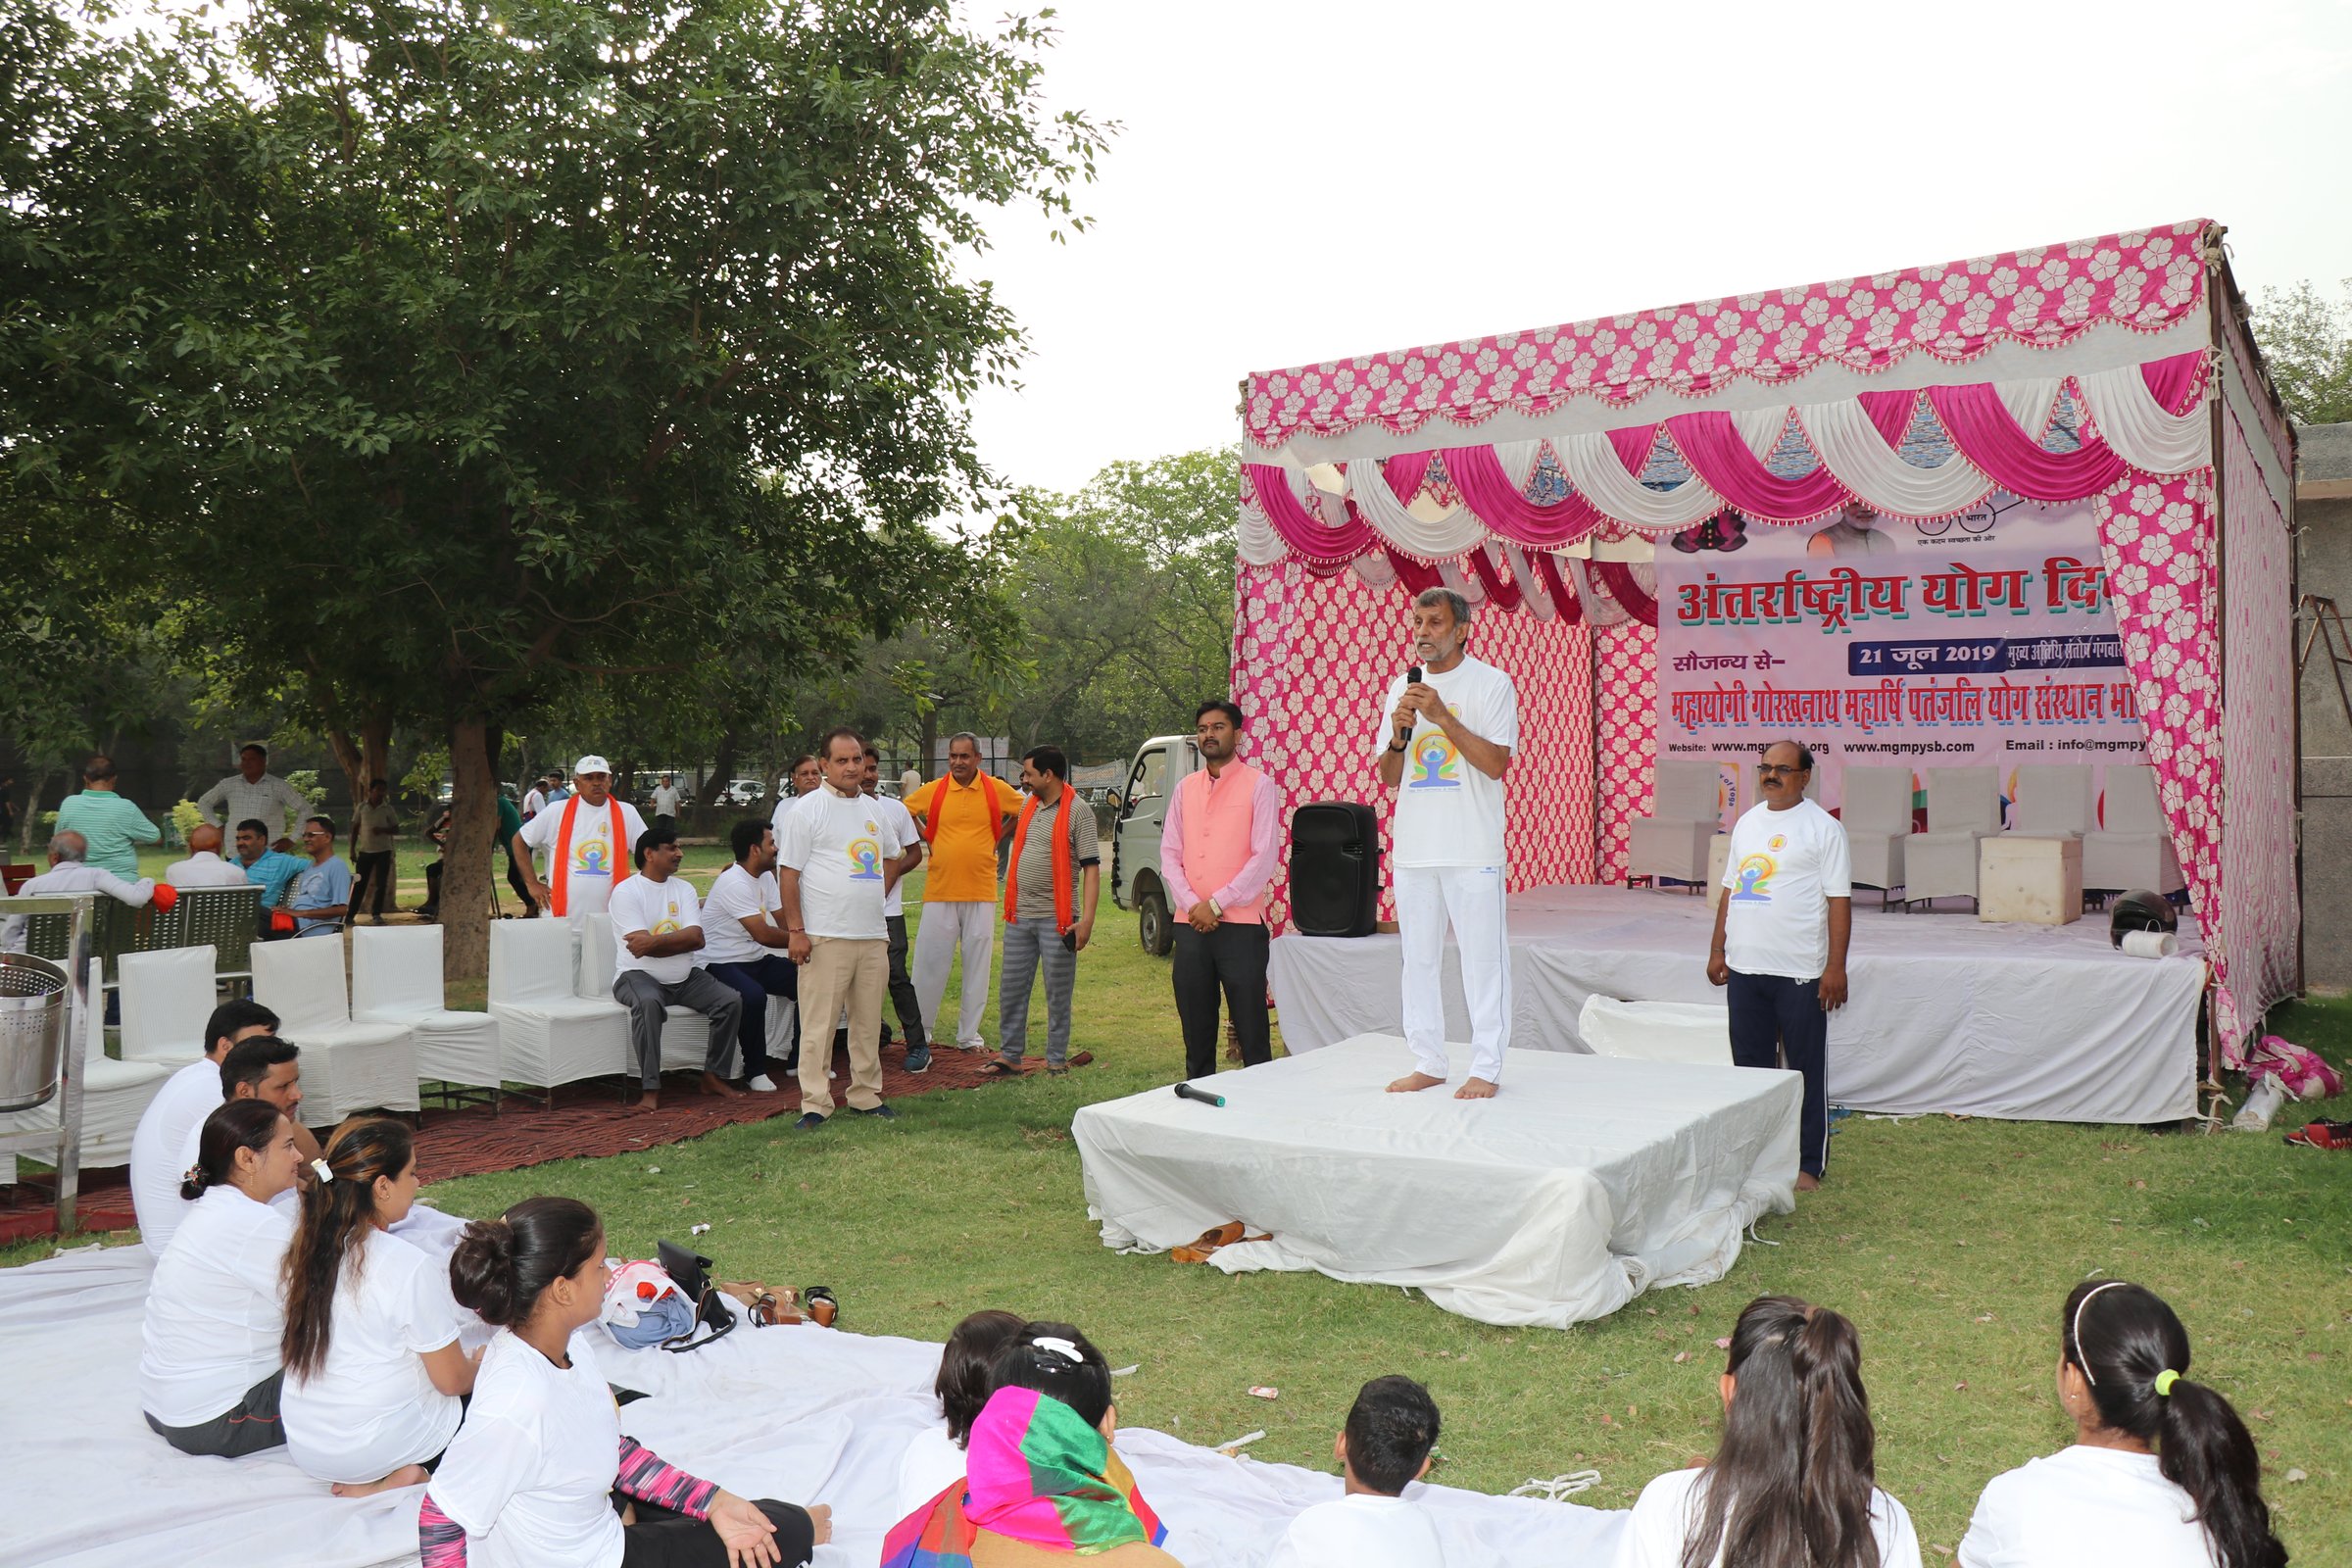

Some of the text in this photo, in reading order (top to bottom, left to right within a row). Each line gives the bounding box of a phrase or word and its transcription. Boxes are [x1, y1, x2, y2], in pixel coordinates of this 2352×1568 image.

[1965, 513, 1987, 522] भारत
[1678, 566, 1910, 630] अंतर्राष्ट्रीय
[1921, 563, 2031, 613] योग
[1673, 650, 1748, 671] सौजन्य
[1859, 645, 1996, 669] 21 जून 2019
[2008, 645, 2030, 667] मुख्य
[2032, 640, 2063, 661] अतिथि
[2065, 637, 2091, 660] संतोष
[1672, 679, 1748, 732] महायोगी
[1752, 680, 1841, 725] गोरखनाथ
[1908, 676, 1984, 724] पतंजलि
[1988, 676, 2031, 722] योग
[2035, 675, 2105, 722] संस्थान
[2111, 682, 2137, 720] भा
[1669, 740, 1975, 755] Website: www.mg.org www.mgmpysb.com
[2006, 739, 2044, 751] Email
[2058, 738, 2146, 753] info@mgmpy
